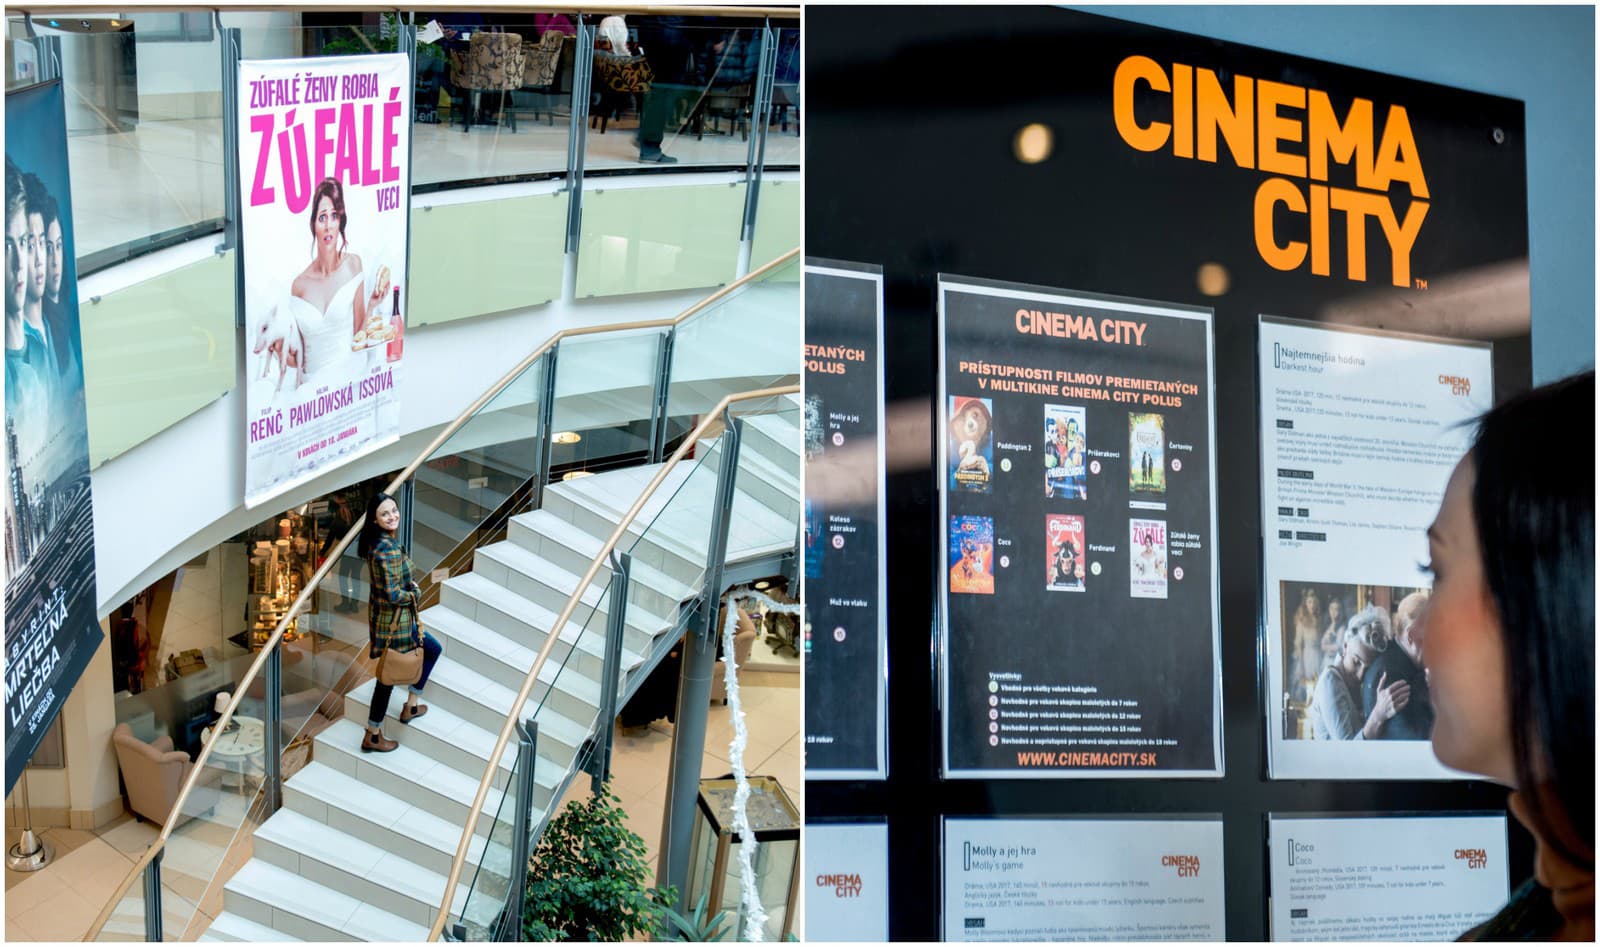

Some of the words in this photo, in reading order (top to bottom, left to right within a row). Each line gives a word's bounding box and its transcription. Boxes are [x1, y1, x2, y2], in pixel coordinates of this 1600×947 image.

[250, 74, 300, 109] ZÚFALÉ
[304, 72, 338, 104] ŽENY
[342, 73, 379, 101] ROBIA
[1113, 55, 1430, 199] CINEMA
[250, 86, 402, 214] ZÚFALÉ
[376, 185, 400, 213] VECI
[1254, 177, 1430, 288] CITY
[1015, 309, 1098, 342] CINEMA
[1101, 319, 1147, 347] CITY
[804, 344, 865, 361] ETANÝCH
[1281, 348, 1336, 364] Najtemnejšia
[1338, 356, 1365, 367] hodina
[1281, 361, 1307, 372] Darkest
[1308, 364, 1323, 373] hour
[959, 360, 1052, 381] PRÍSTUPNOSTI
[1056, 370, 1103, 386] FILMOV
[1106, 376, 1198, 396] PREMIETANÝCH
[1438, 374, 1470, 387] CINEMA
[978, 378, 987, 389] V
[990, 379, 1058, 396] MULTIKINE
[1061, 386, 1110, 401] CINEMA
[1113, 391, 1140, 403] CITY
[1143, 394, 1182, 408] POLUS
[1452, 384, 1471, 396] CITY
[250, 410, 283, 443] RENČ
[290, 382, 353, 428] PAWLOWSKÁ
[359, 367, 393, 400] ISSOVÁ
[997, 442, 1027, 451] Paddington
[998, 538, 1011, 546] Coco
[1089, 544, 1115, 552] Ferdinand
[10, 645, 60, 728] LIEČBA
[1017, 752, 1157, 767] WWW.CINEMACITY.SK
[972, 846, 997, 857] Molly
[1007, 846, 1018, 858] jej
[1021, 846, 1036, 856] hra
[1295, 842, 1314, 852] Coco
[1295, 856, 1312, 865] Coco
[1454, 849, 1487, 860] CINEMA
[1002, 862, 1024, 871] game
[1161, 856, 1200, 867] CINEMA
[1468, 858, 1487, 869] CITY
[1177, 866, 1200, 877] CITY
[816, 873, 862, 887] CINEMA
[835, 886, 862, 898] CITY
